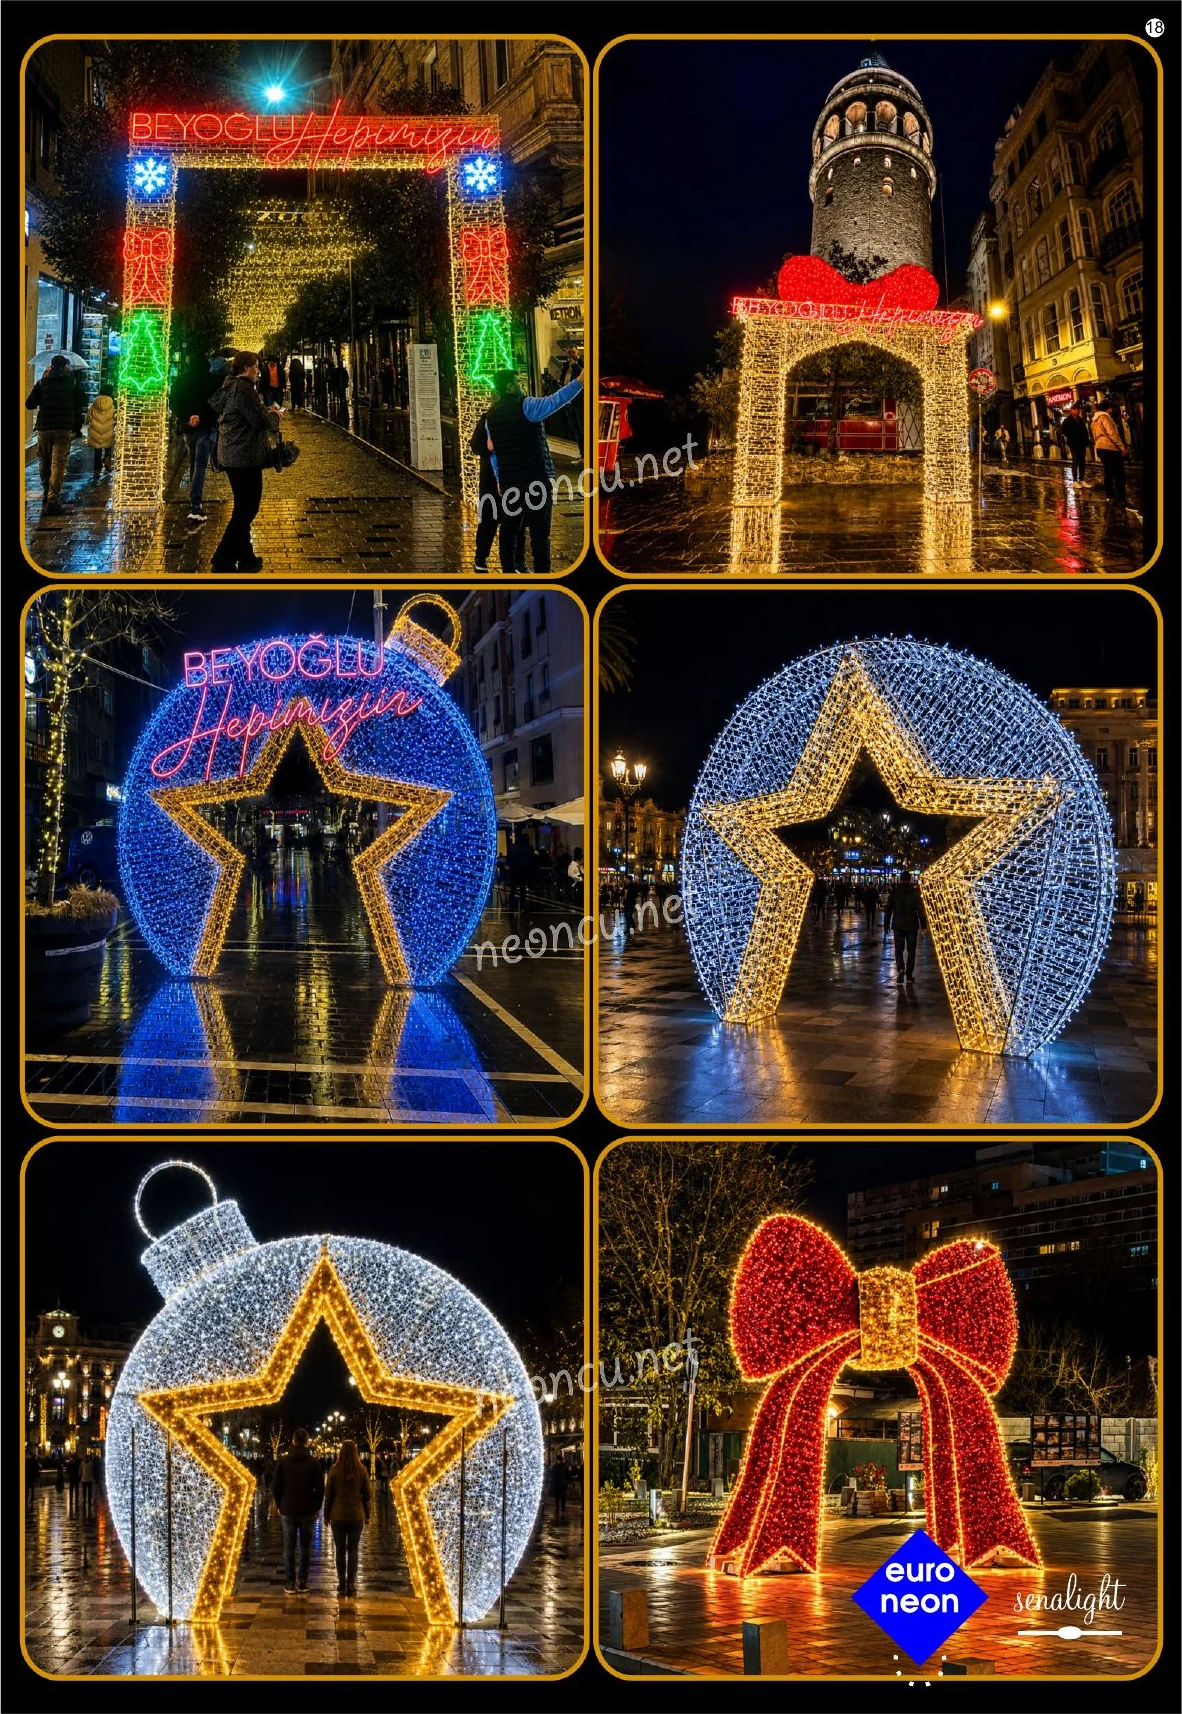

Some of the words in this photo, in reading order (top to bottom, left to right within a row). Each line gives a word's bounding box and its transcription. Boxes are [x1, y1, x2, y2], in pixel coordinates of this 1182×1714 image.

[131, 112, 295, 141] BEYOĞLU
[731, 295, 848, 321] BEYOĞLU
[183, 633, 385, 688] BEYOĞLU
